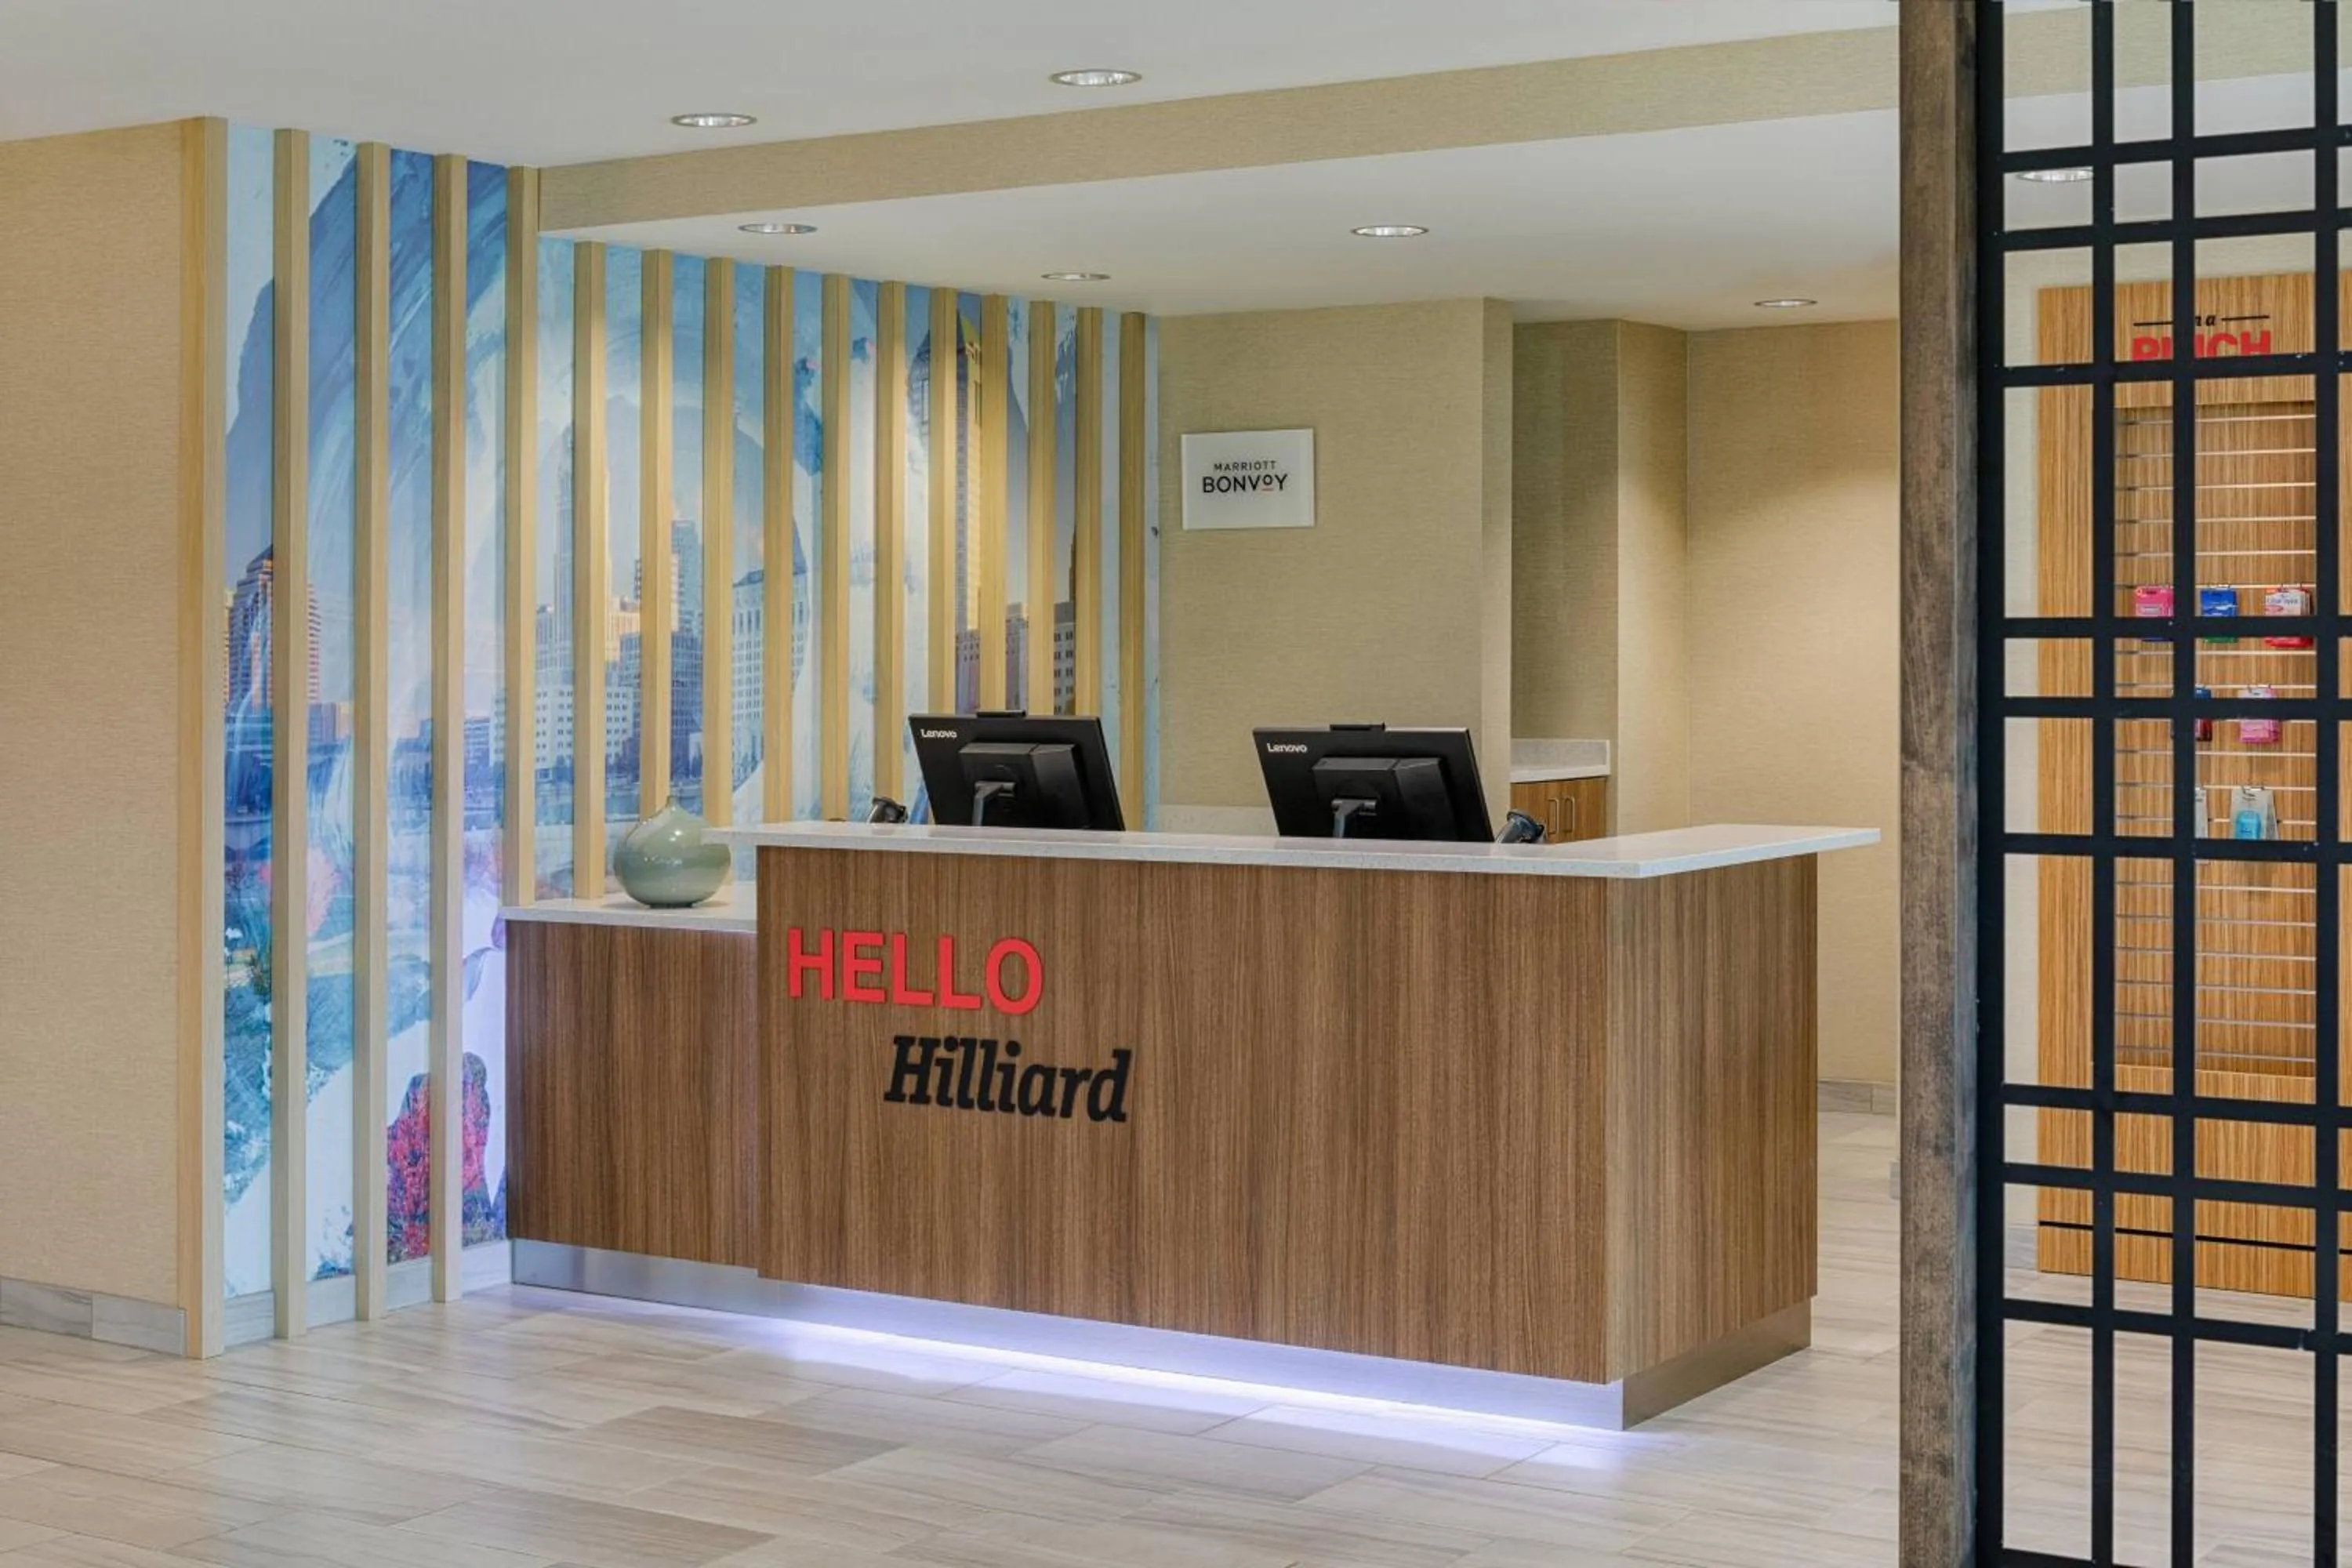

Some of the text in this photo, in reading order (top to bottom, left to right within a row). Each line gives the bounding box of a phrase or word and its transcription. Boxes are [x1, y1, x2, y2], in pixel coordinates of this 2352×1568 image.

[1214, 460, 1276, 471] MARRIOTT
[1202, 474, 1288, 493] BONVOY
[920, 728, 957, 739] Lenovo
[1267, 742, 1308, 753] Lenovo
[788, 928, 1043, 1014] HELLO
[884, 1035, 1132, 1123] Hilliard
